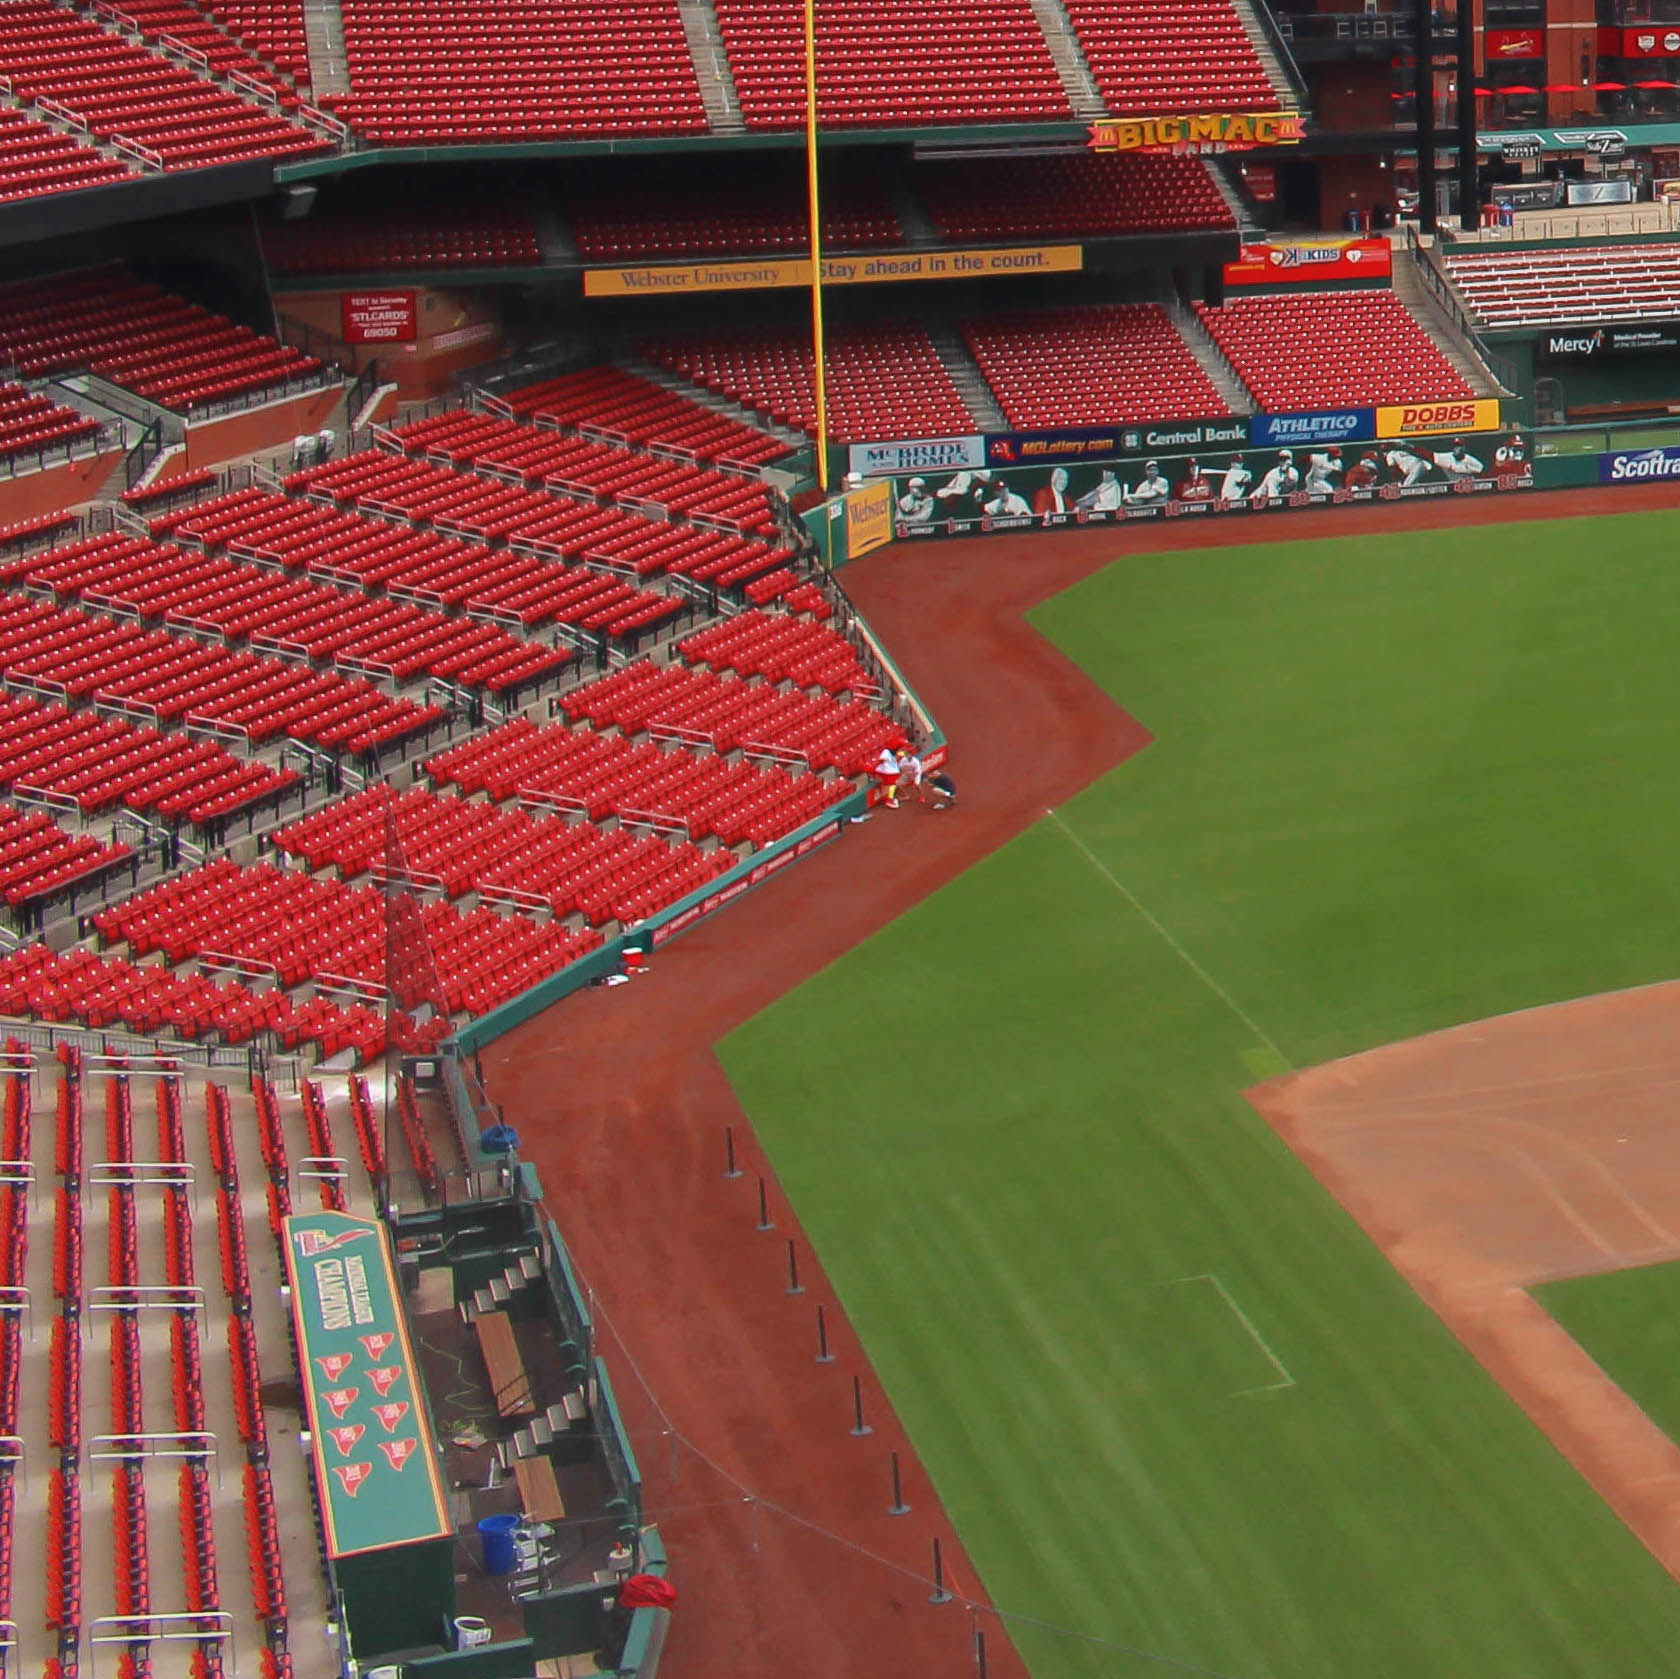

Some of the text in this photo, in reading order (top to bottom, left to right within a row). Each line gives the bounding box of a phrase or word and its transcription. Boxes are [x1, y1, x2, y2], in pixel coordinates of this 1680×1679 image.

[1117, 115, 1280, 151] BIG MAC
[1172, 143, 1227, 157] LAND
[1307, 248, 1338, 260] KIDS
[620, 251, 1050, 288] Webster University Stay ahead in the count.
[1550, 337, 1594, 355] Mercy
[1613, 333, 1636, 341] Medical
[1403, 404, 1475, 424] DOBBS
[1268, 415, 1358, 435] ATHLETICO
[1147, 425, 1247, 447] Central Bank
[898, 455, 969, 468] HOMES
[314, 1258, 352, 1331] CHAMPIONS
